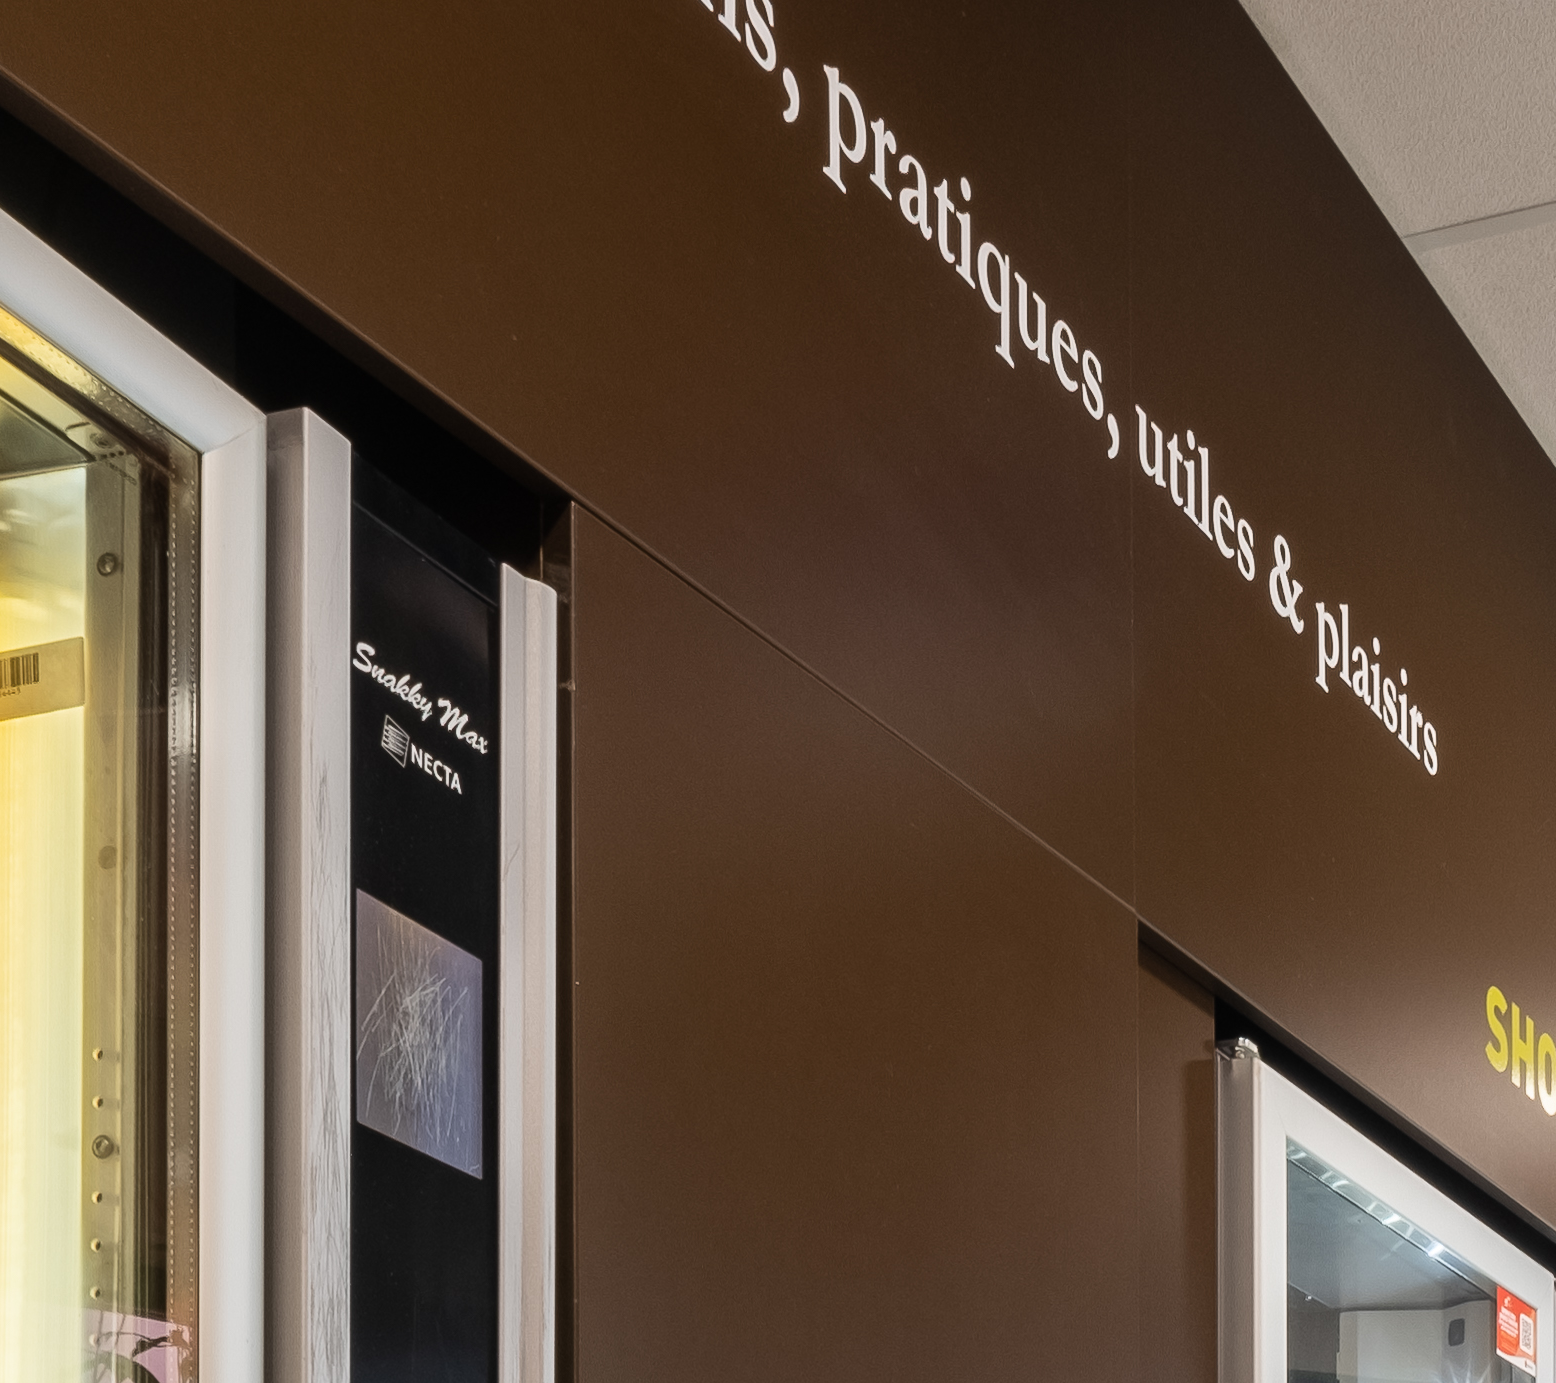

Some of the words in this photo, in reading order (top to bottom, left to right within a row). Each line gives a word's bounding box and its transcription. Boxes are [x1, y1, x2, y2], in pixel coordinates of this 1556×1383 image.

[823, 64, 1121, 460] pratiques,
[1135, 404, 1256, 581] utiles
[1269, 534, 1305, 634] &
[1315, 601, 1438, 777] plaisirs
[352, 641, 433, 722] Snakky
[437, 697, 489, 755] Max
[410, 742, 463, 796] NECTA
